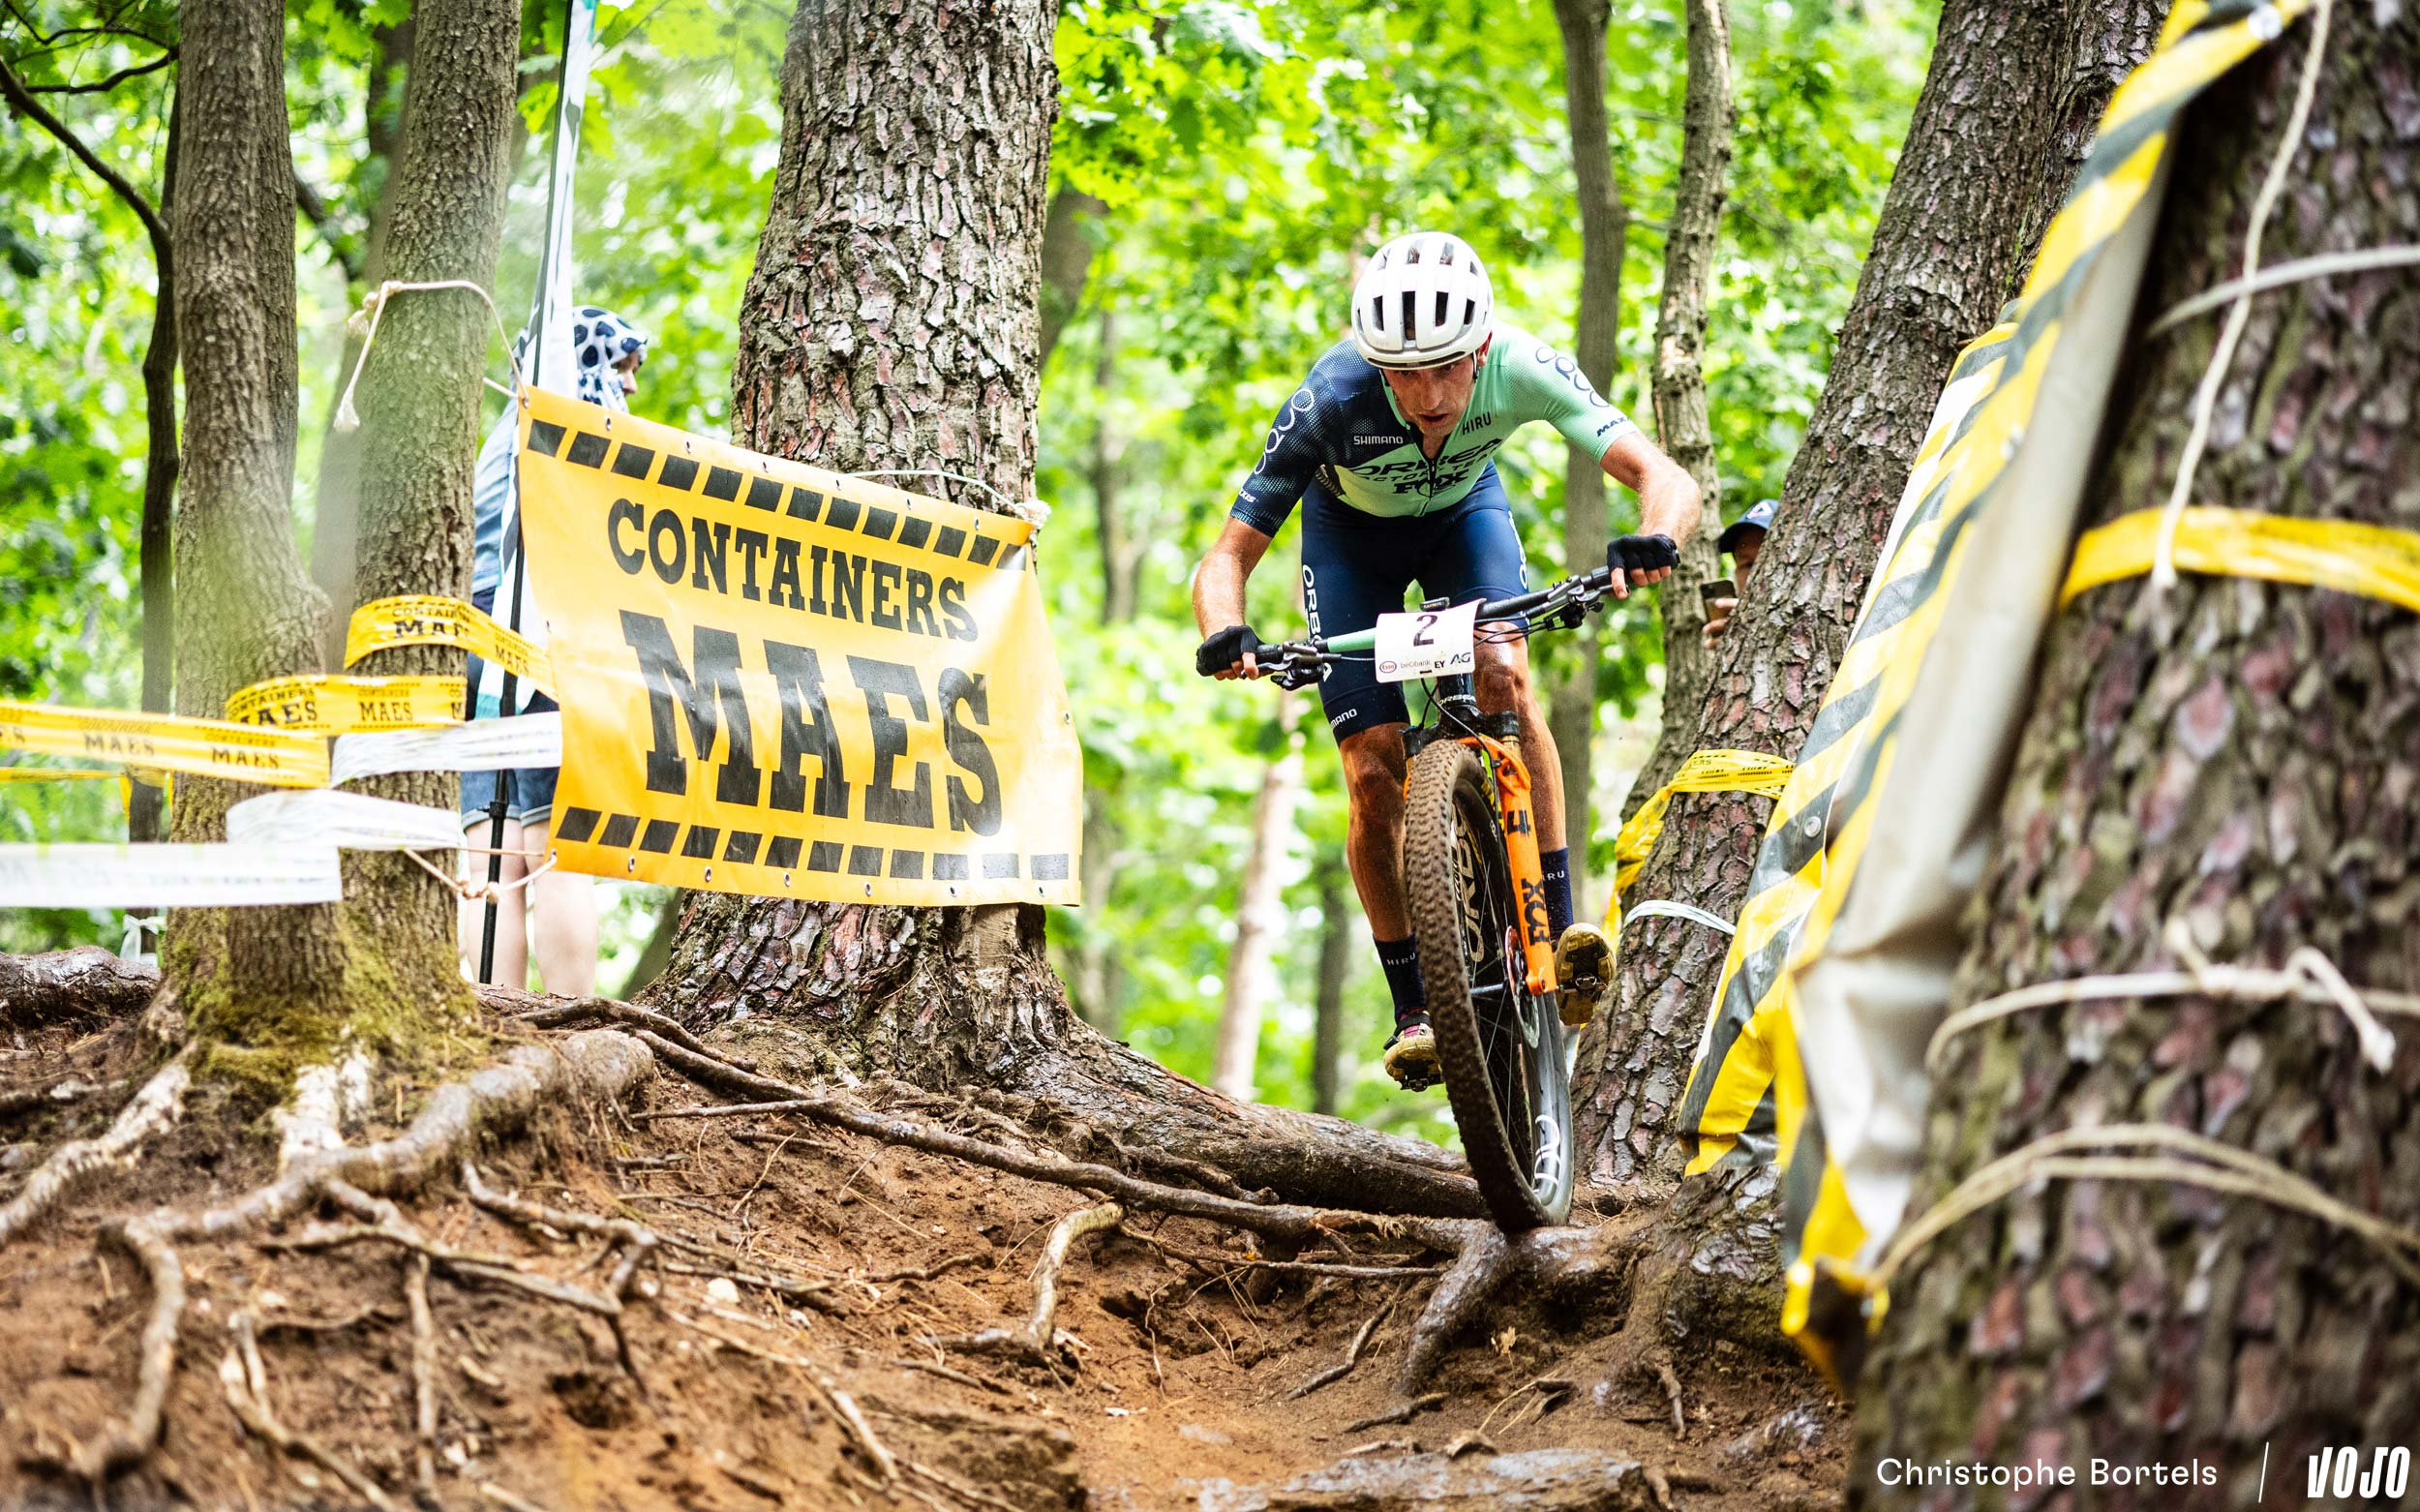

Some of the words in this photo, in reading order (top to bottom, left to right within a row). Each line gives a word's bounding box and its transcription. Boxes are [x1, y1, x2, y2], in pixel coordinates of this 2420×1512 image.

[1463, 411, 1492, 436] HIRU
[1353, 436, 1404, 445] SHIMANO
[607, 498, 979, 643] CONTAINERS
[1302, 563, 1333, 683] ORBA
[1413, 614, 1438, 647] 2
[1434, 660, 1445, 669] EY
[360, 702, 412, 722] MAES
[618, 609, 1003, 837] MAES
[83, 733, 155, 757] MAES
[211, 746, 280, 770] MAES
[1521, 877, 1550, 947] FOX
